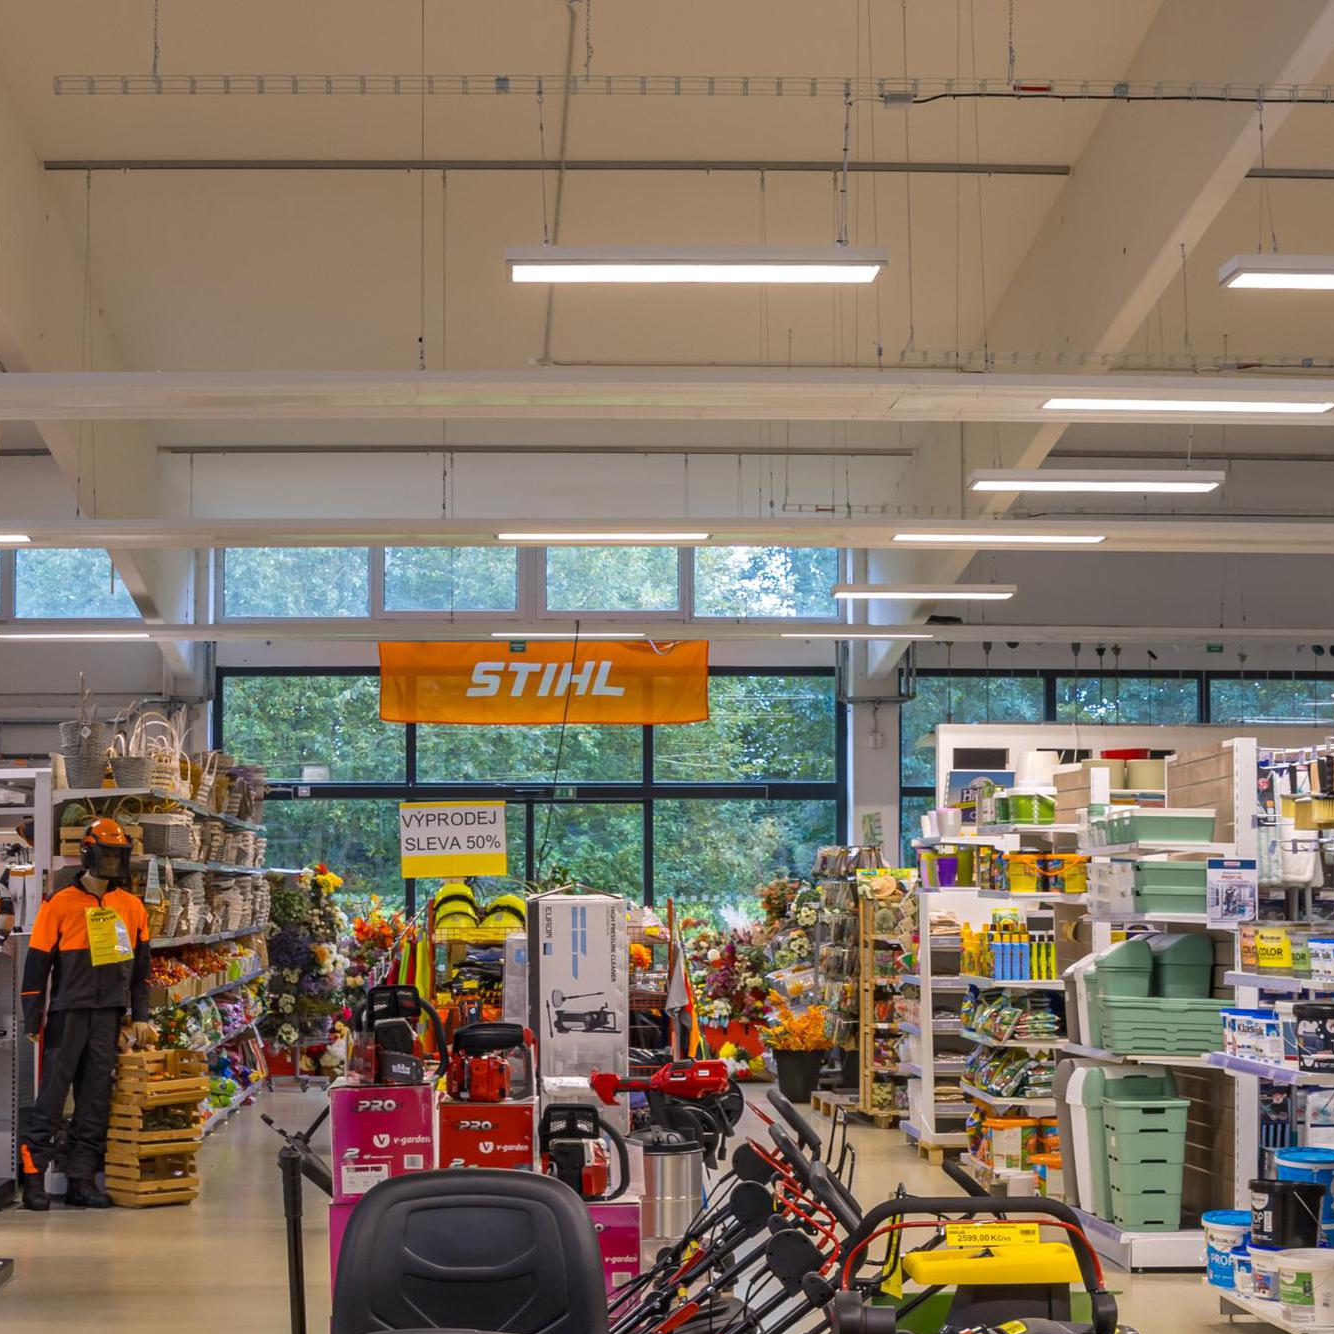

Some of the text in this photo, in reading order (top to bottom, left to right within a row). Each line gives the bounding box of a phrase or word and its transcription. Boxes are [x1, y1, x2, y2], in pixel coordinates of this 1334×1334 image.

[466, 661, 625, 697] STIHL
[402, 810, 497, 828] VÝPRODEJ
[405, 835, 501, 851] SLEVA 50%
[1258, 949, 1284, 957] COLOR
[357, 1100, 397, 1112] PRO
[458, 1120, 492, 1131] PRO
[393, 1135, 431, 1146] v-garden
[496, 1143, 528, 1152] v-garden
[604, 1255, 637, 1265] v-garden
